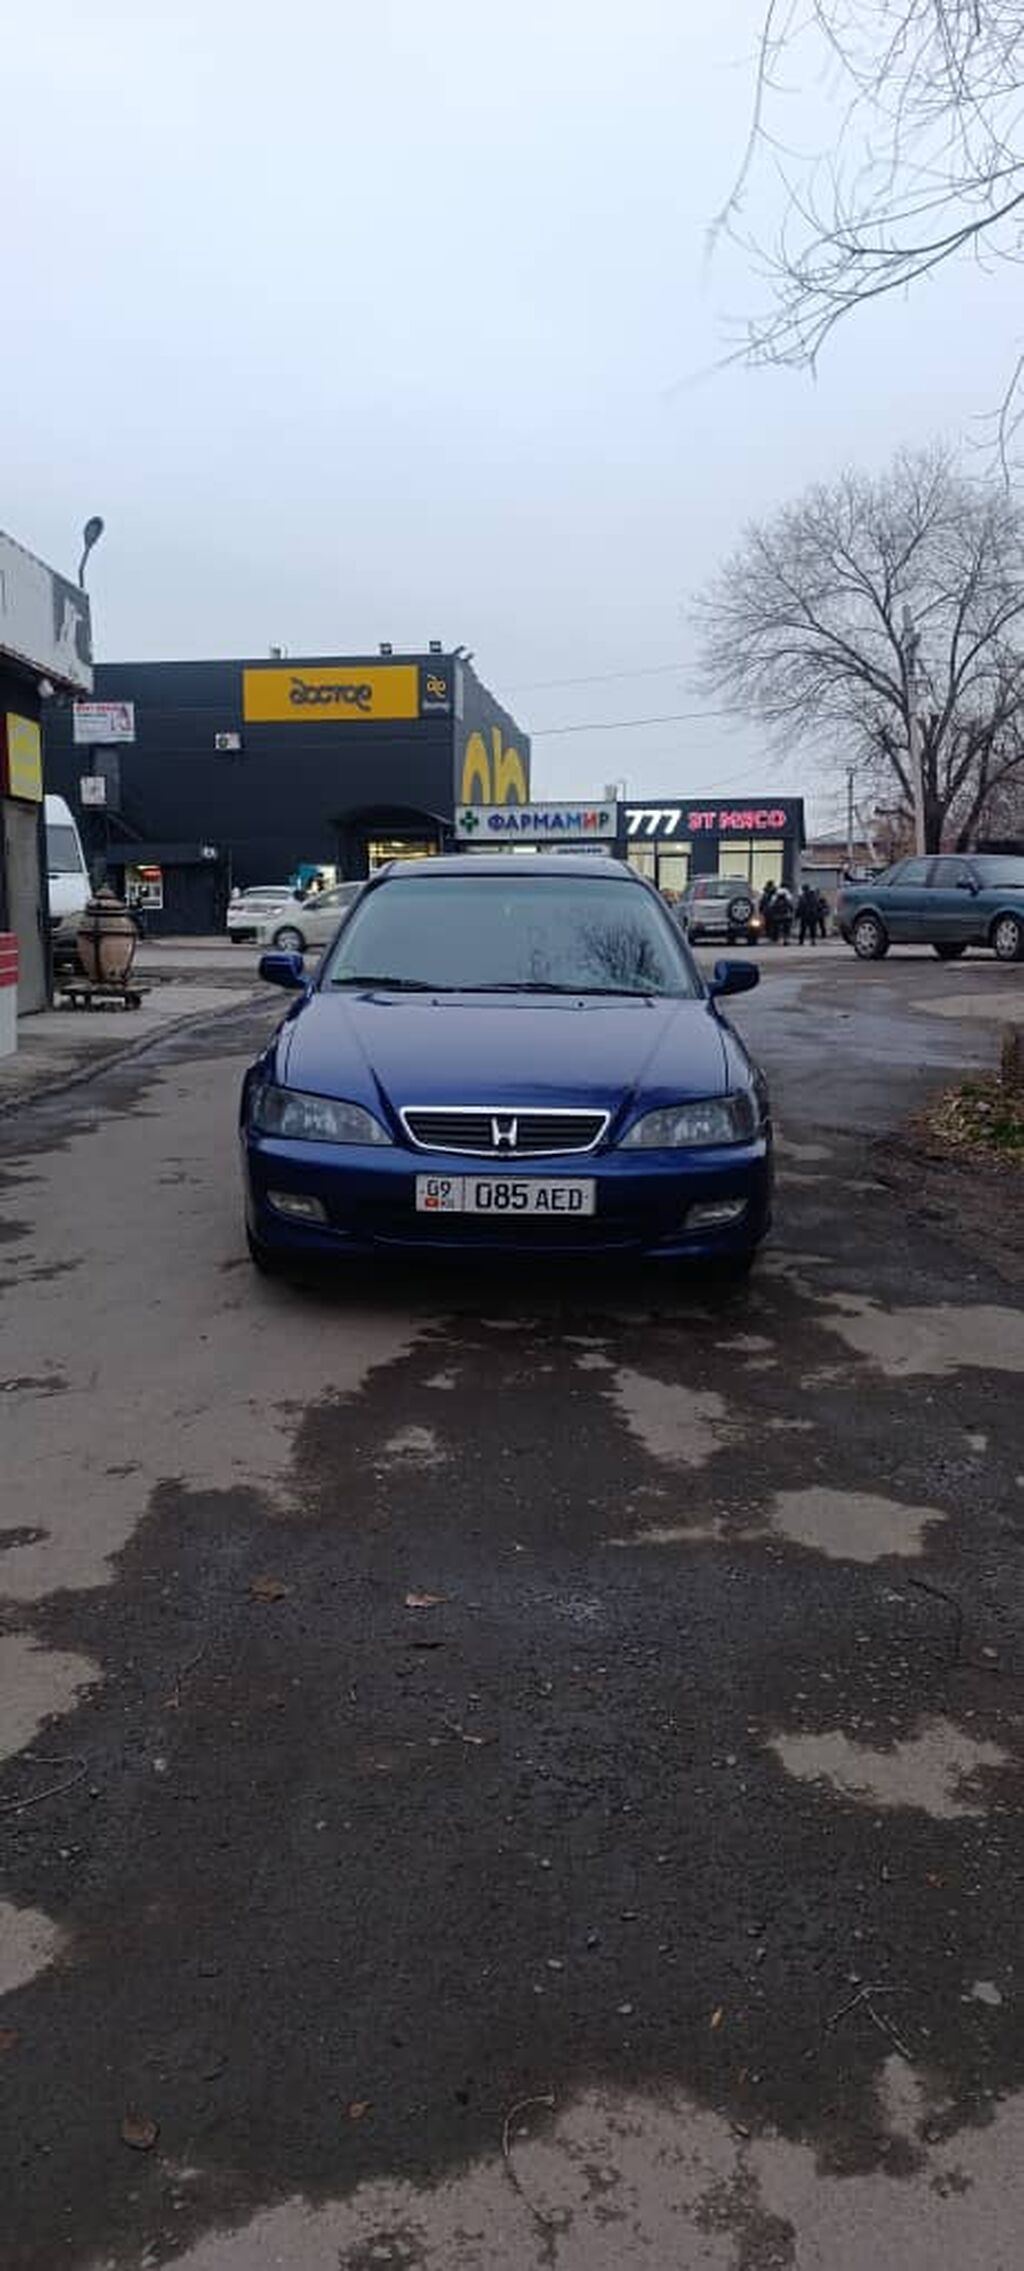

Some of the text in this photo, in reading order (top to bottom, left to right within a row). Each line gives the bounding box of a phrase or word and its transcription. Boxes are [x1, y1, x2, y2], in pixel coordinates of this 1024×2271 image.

[487, 812, 610, 832] ФАРМАМИР
[624, 809, 682, 835] 777
[719, 810, 785, 829] МЯСО
[475, 1183, 582, 1211] 085 AED
